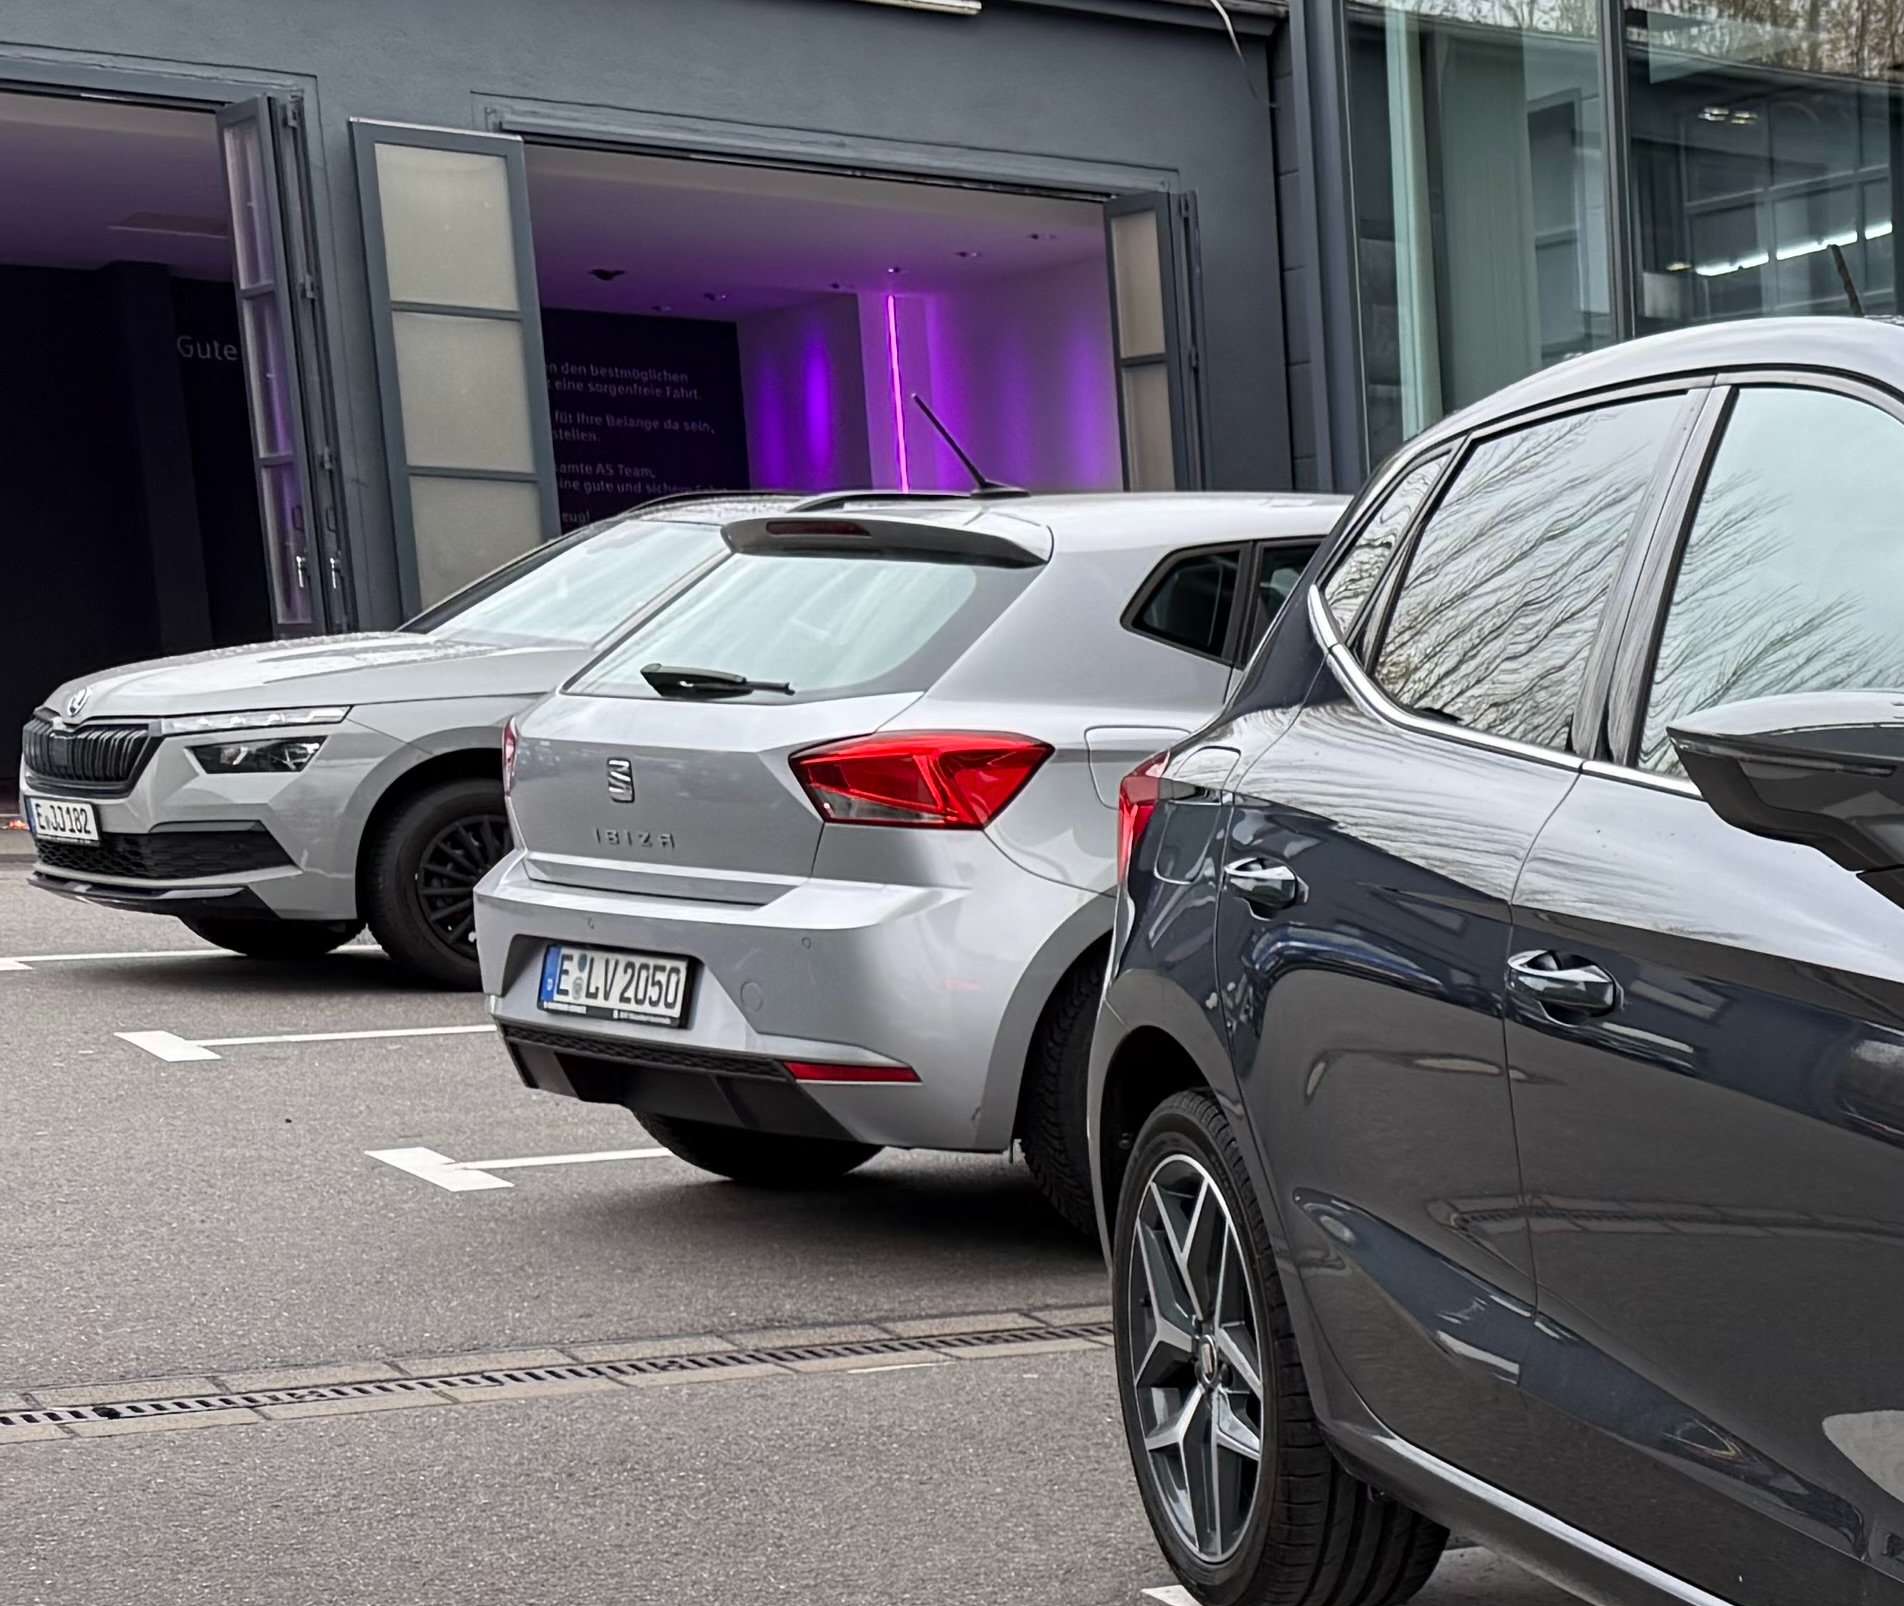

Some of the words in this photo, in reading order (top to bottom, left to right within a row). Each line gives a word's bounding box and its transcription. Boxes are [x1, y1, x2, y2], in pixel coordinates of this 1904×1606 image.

[176, 335, 239, 361] Gute
[561, 362, 587, 376] den
[663, 418, 680, 431] da
[34, 803, 47, 830] E
[65, 806, 93, 834] 182
[595, 827, 676, 849] IBIZA
[556, 953, 574, 996] E
[584, 956, 620, 1002] LV
[618, 960, 682, 1010] 2050
